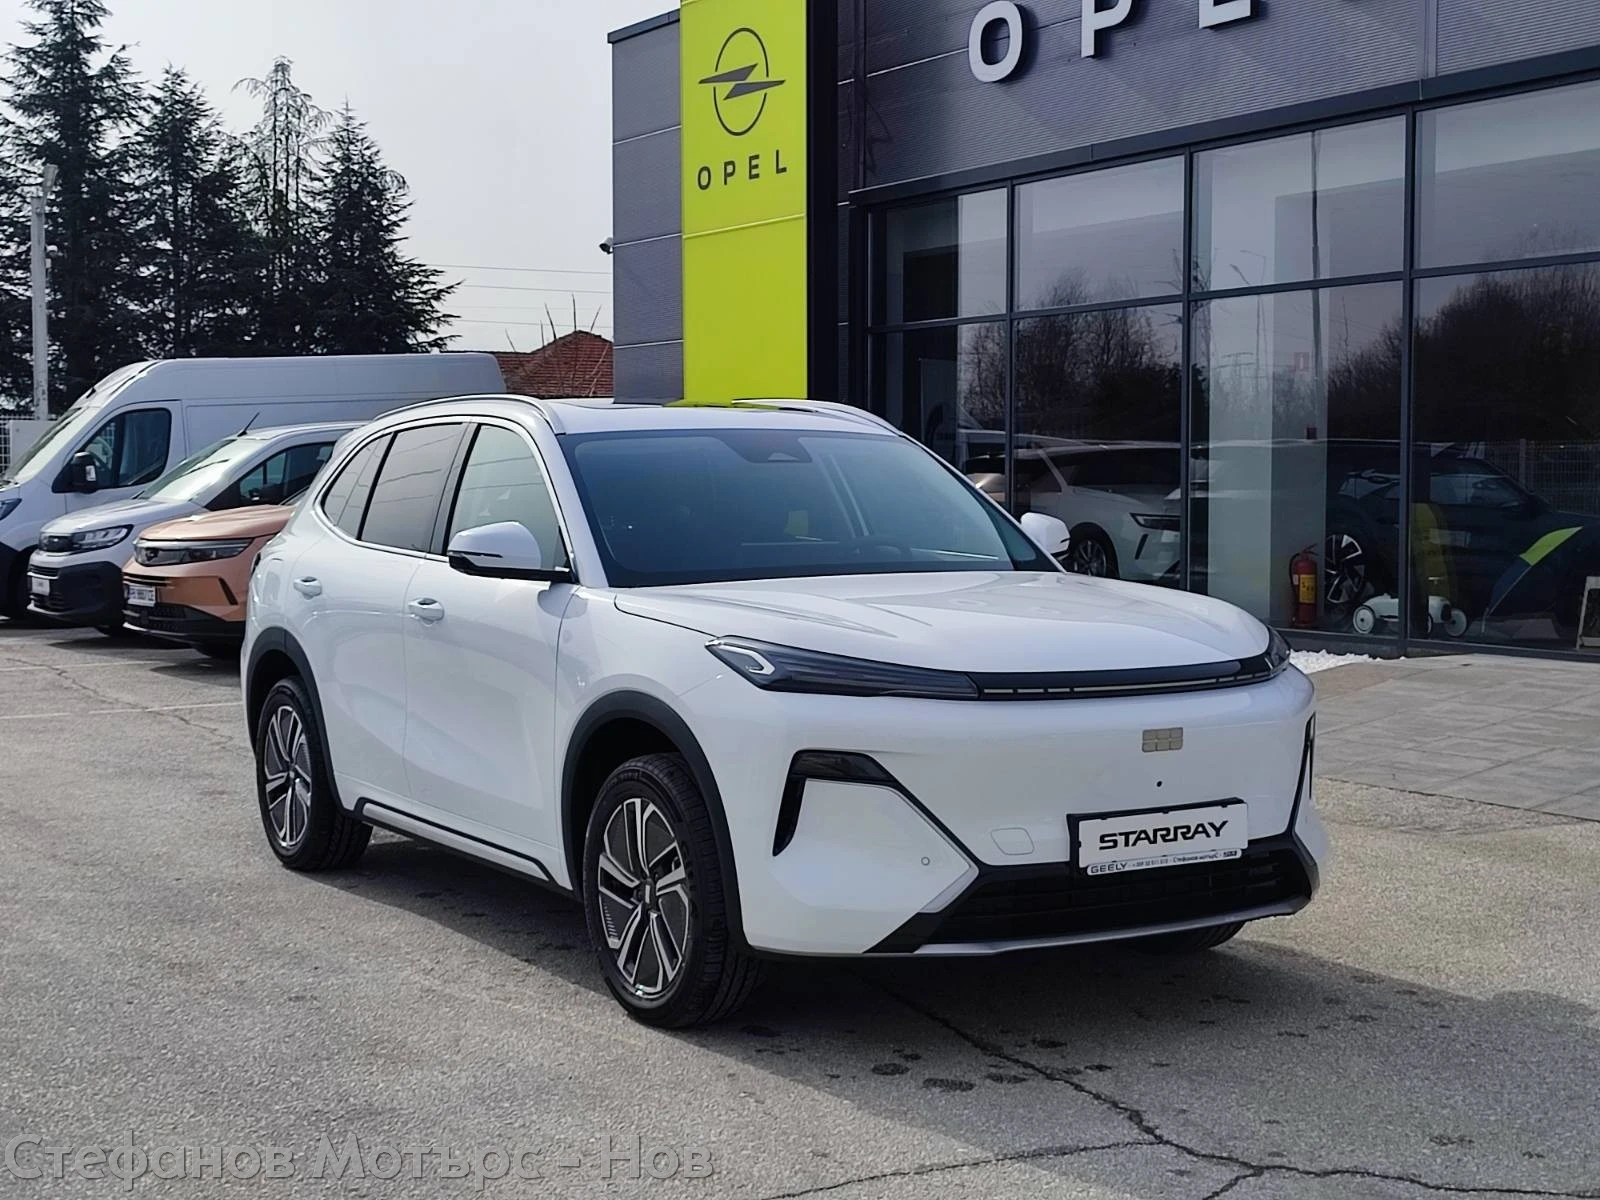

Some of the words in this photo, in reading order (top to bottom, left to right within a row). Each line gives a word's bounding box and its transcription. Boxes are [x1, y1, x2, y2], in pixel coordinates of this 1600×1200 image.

[697, 149, 788, 191] OPEL
[1098, 820, 1229, 851] STARRAY
[1090, 861, 1128, 874] GEELY
